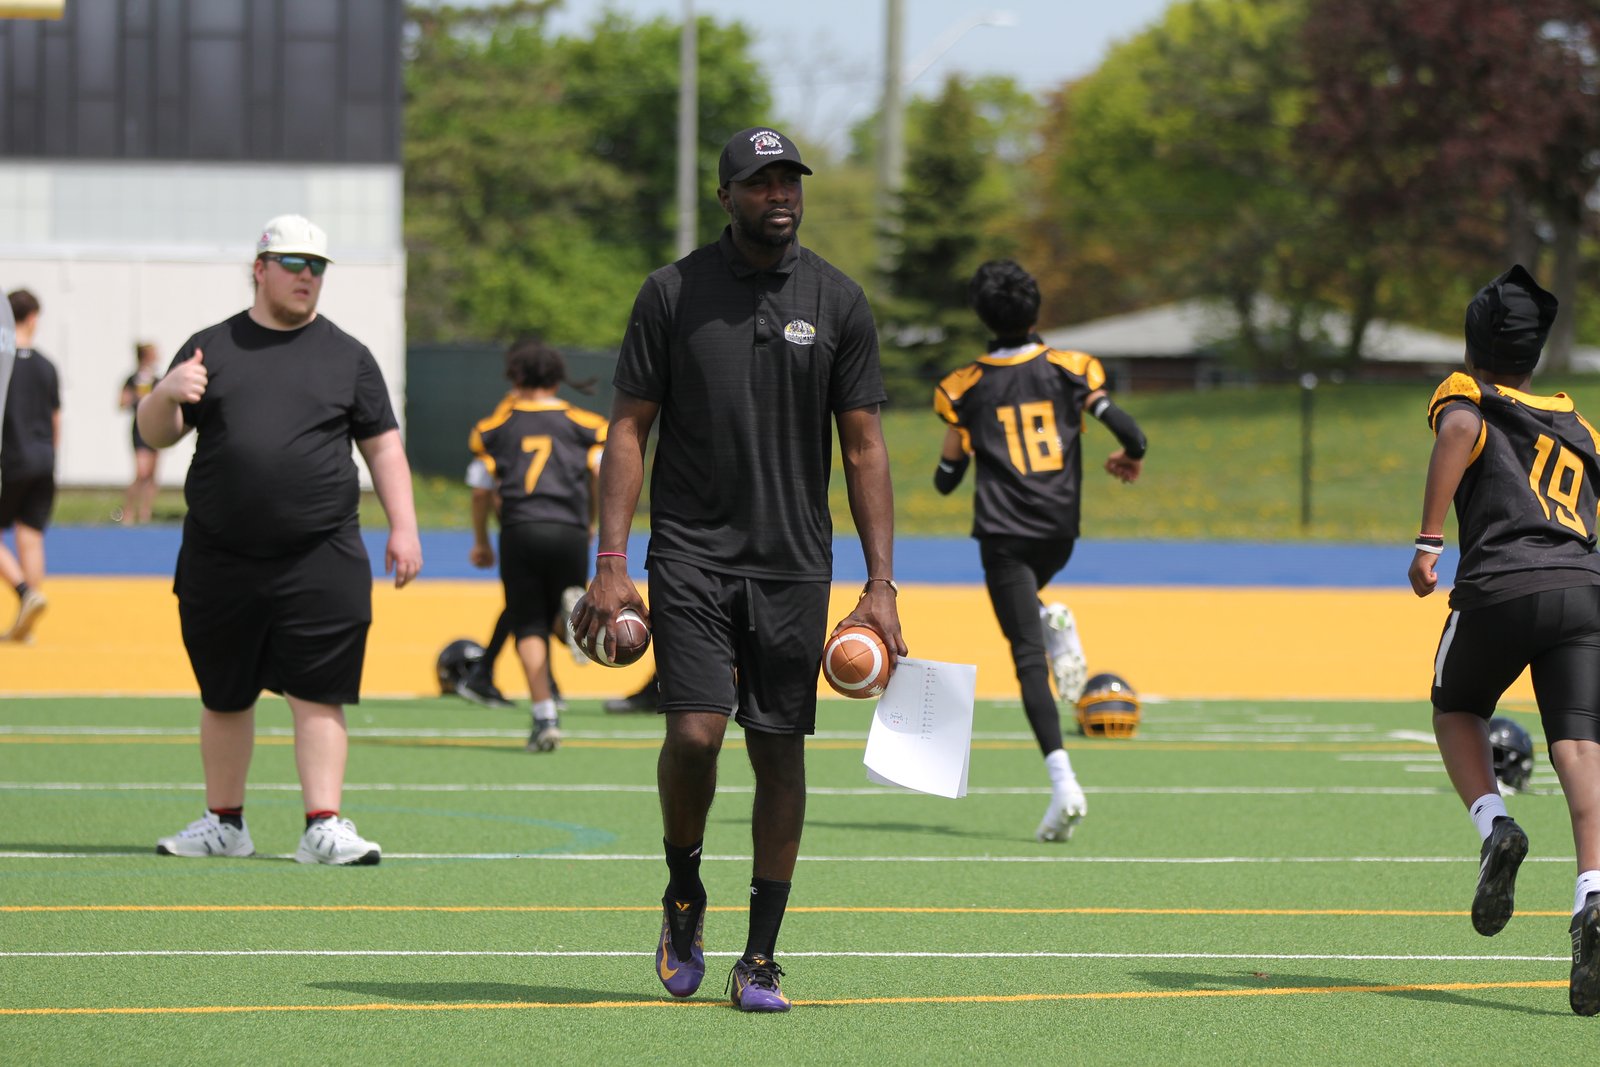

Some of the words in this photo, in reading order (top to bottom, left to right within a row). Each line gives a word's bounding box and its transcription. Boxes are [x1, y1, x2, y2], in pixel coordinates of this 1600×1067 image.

[520, 435, 553, 495] 7
[996, 400, 1064, 476] 18
[1529, 433, 1588, 538] 19
